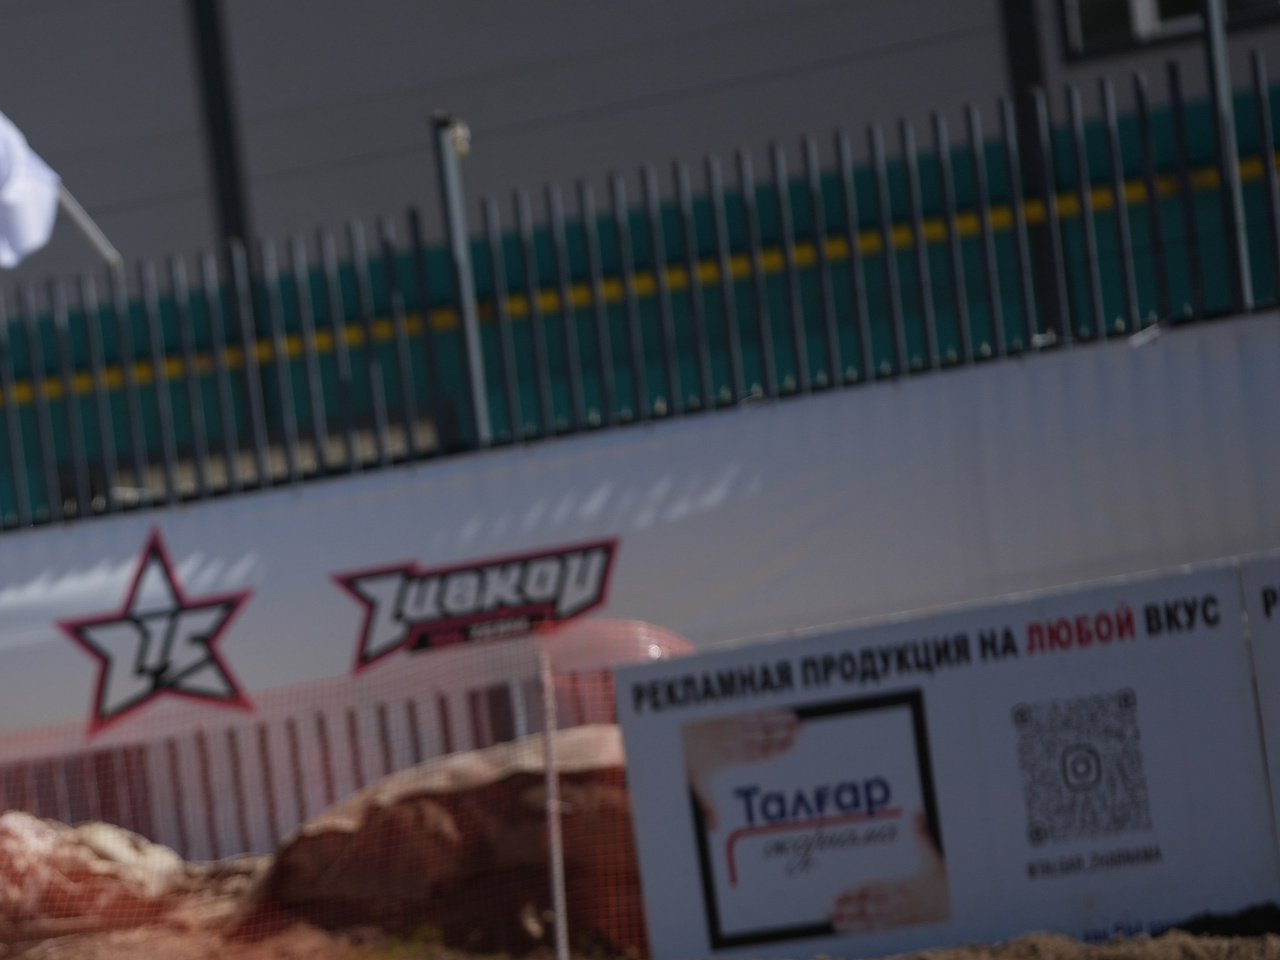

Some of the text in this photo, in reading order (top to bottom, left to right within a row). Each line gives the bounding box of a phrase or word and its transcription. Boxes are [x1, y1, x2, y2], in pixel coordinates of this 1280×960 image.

[631, 594, 1221, 711] РЕКЛАМНАЯ ПРОДУКЦИЯ НА ЛЮБОЙ ВКУС
